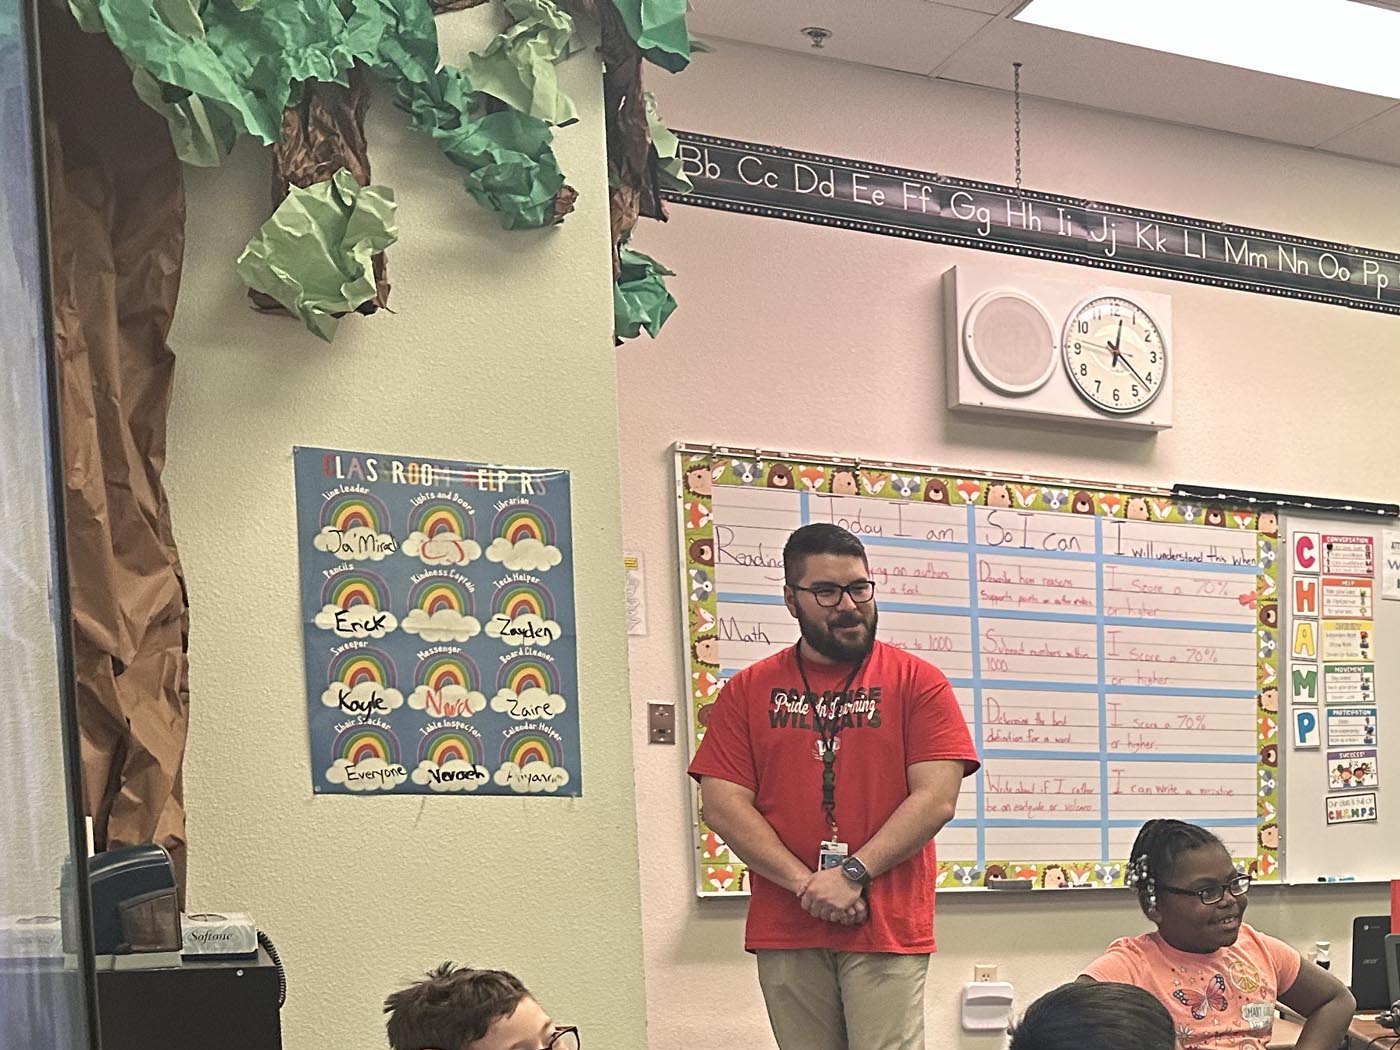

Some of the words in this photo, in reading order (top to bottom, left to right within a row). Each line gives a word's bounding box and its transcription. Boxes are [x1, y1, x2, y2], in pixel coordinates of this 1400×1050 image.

[680, 145, 721, 179] Bb
[738, 156, 778, 189] Cc
[795, 163, 834, 197] Dd
[853, 174, 885, 206] Ee
[903, 183, 933, 213] Ff
[950, 191, 990, 236] Gg
[1007, 201, 1042, 231] Hh
[1057, 208, 1072, 237] Ii
[1089, 215, 1117, 257] Jj
[1136, 222, 1167, 254] Kk
[1185, 230, 1206, 258] Ll
[1225, 240, 1267, 268] Mm
[1278, 246, 1308, 275] Nn
[1319, 253, 1350, 281] Oo
[1363, 261, 1388, 299] Pp
[1078, 320, 1089, 334] 10
[1144, 329, 1151, 343] 2
[1074, 343, 1082, 355] 9
[1150, 352, 1157, 363] 3
[1080, 364, 1087, 376] 8
[1146, 372, 1152, 384] 4
[1095, 380, 1101, 393] 7
[1132, 384, 1138, 397] 5
[1113, 389, 1119, 401] 6
[323, 455, 450, 487] CLASROOM
[463, 469, 546, 496] HELPRS
[926, 528, 954, 541] am
[985, 510, 1013, 547] So
[1018, 512, 1035, 550] I
[1042, 532, 1081, 552] can
[1111, 520, 1126, 556] I
[1157, 547, 1203, 563] understand
[1206, 544, 1227, 563] this
[1296, 536, 1315, 568] C
[1193, 578, 1229, 597] 70%
[1295, 580, 1315, 612] H
[718, 616, 771, 646] Math
[330, 640, 369, 656] Sweeper
[1294, 623, 1315, 657] A
[417, 645, 461, 660] Messenger
[1185, 647, 1218, 664] 70%
[1334, 666, 1364, 674] MOVEMENT
[1292, 669, 1317, 698] M
[774, 693, 810, 714] Pride
[1177, 714, 1206, 730] 70%
[1297, 712, 1315, 743] P
[344, 763, 407, 783] Everyone
